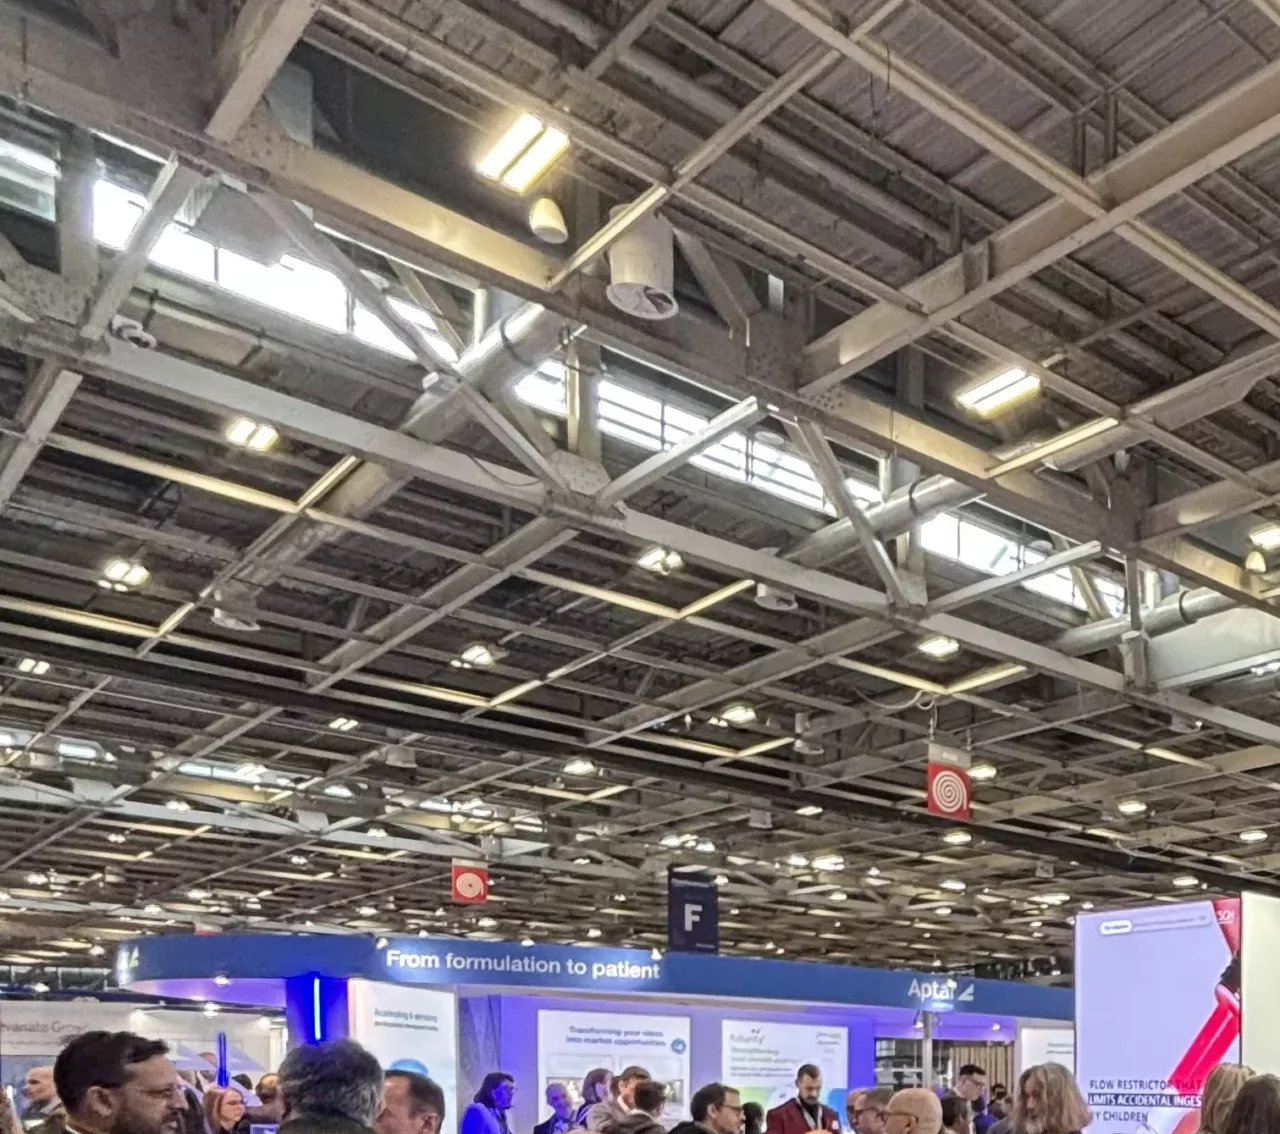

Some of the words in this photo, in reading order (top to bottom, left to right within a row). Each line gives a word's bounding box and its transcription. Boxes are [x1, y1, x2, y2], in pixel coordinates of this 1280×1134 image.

[684, 903, 703, 932] F
[386, 949, 440, 969] From
[446, 953, 560, 974] formulation
[567, 959, 586, 975] to
[592, 960, 660, 980] patient
[908, 978, 955, 1001] Aptar
[1089, 1079, 1115, 1090] FLOW
[1117, 1079, 1173, 1091] RESTRICTOR
[1089, 1094, 1115, 1106] LIMITS
[1119, 1094, 1172, 1107] ACCIDENTAL
[1102, 1111, 1149, 1122] CHILDREN
